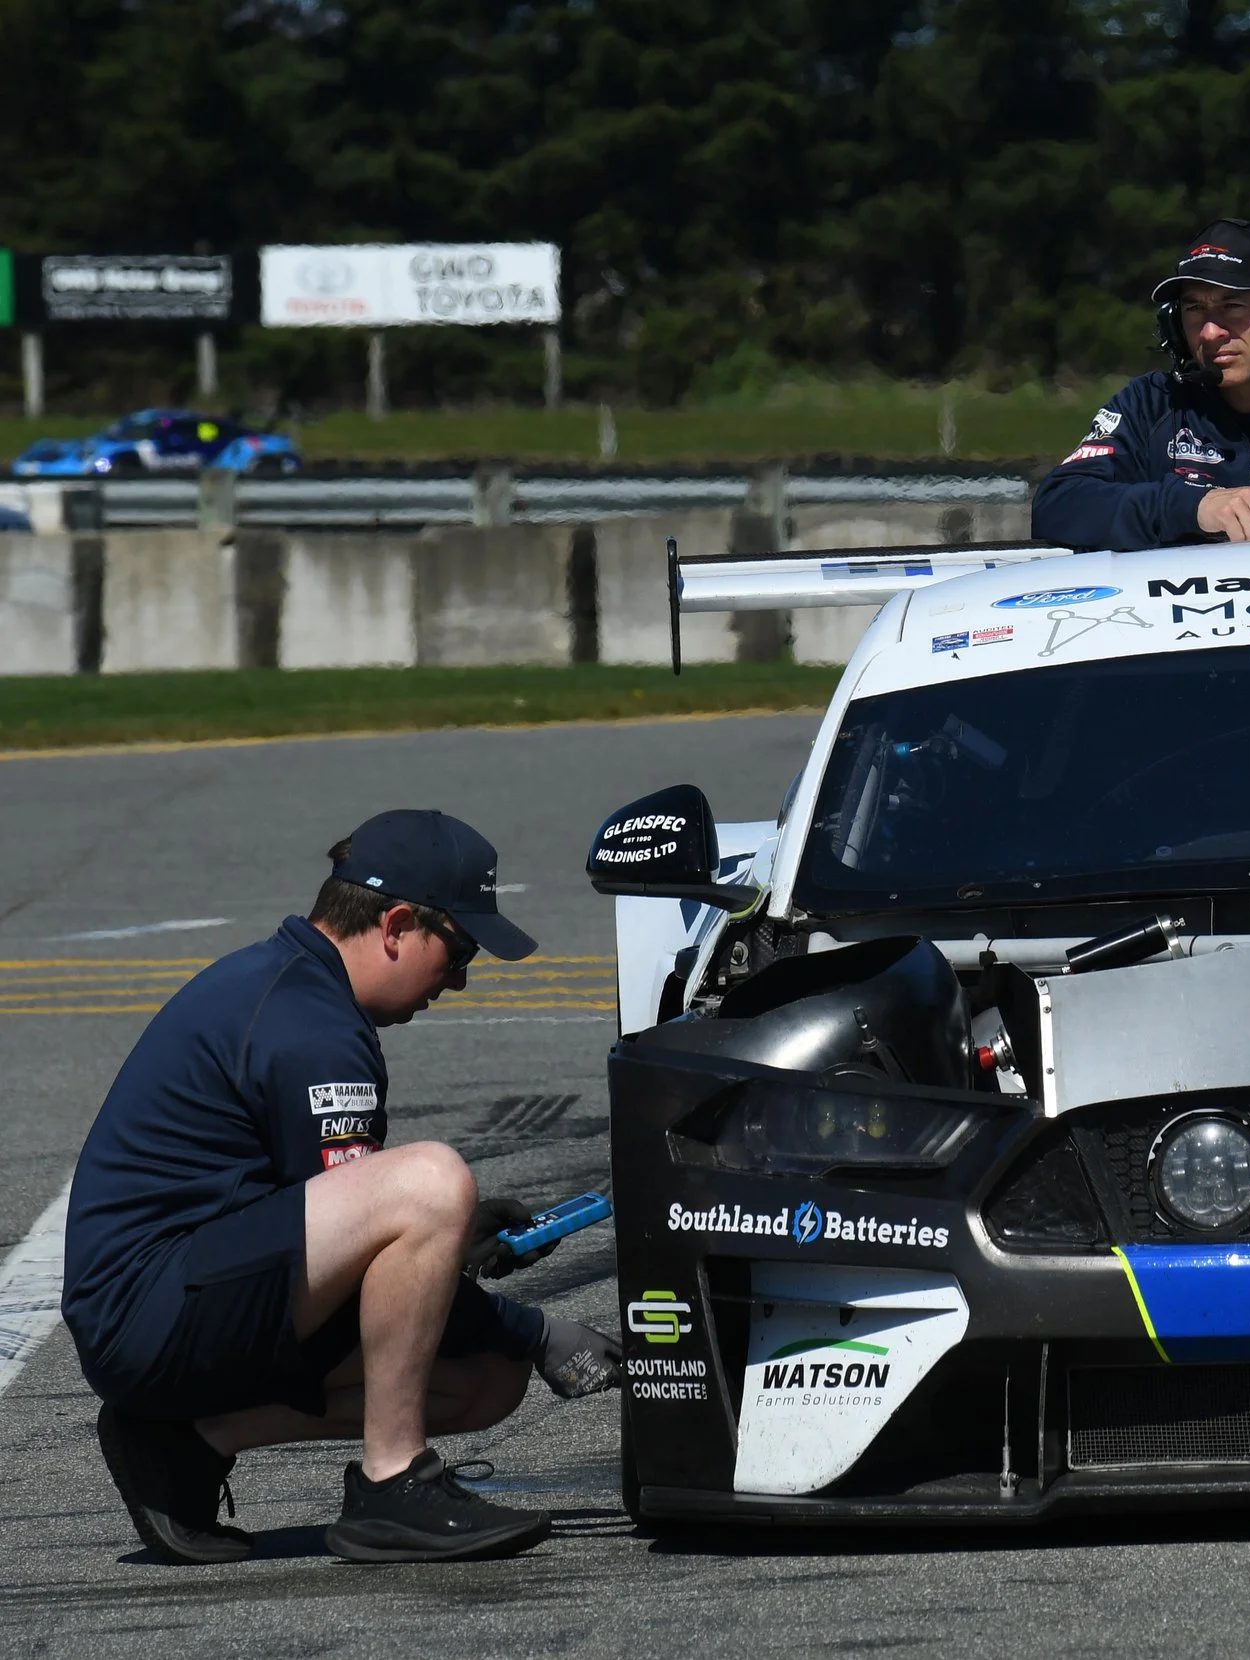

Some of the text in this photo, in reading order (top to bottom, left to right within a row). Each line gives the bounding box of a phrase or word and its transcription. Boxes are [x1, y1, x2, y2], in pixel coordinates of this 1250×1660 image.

[1015, 588, 1097, 606] Ford
[603, 815, 687, 839] GLENSPEC
[595, 841, 677, 863] HOLDINGS LTD
[334, 1085, 375, 1097] HAAKMAN
[667, 1202, 949, 1248] Southland Batteries
[627, 1359, 706, 1377] SOUTHLAND
[762, 1363, 890, 1389] WATSON
[632, 1382, 702, 1399] CONCRETE
[756, 1393, 882, 1407] Farm Solutions
